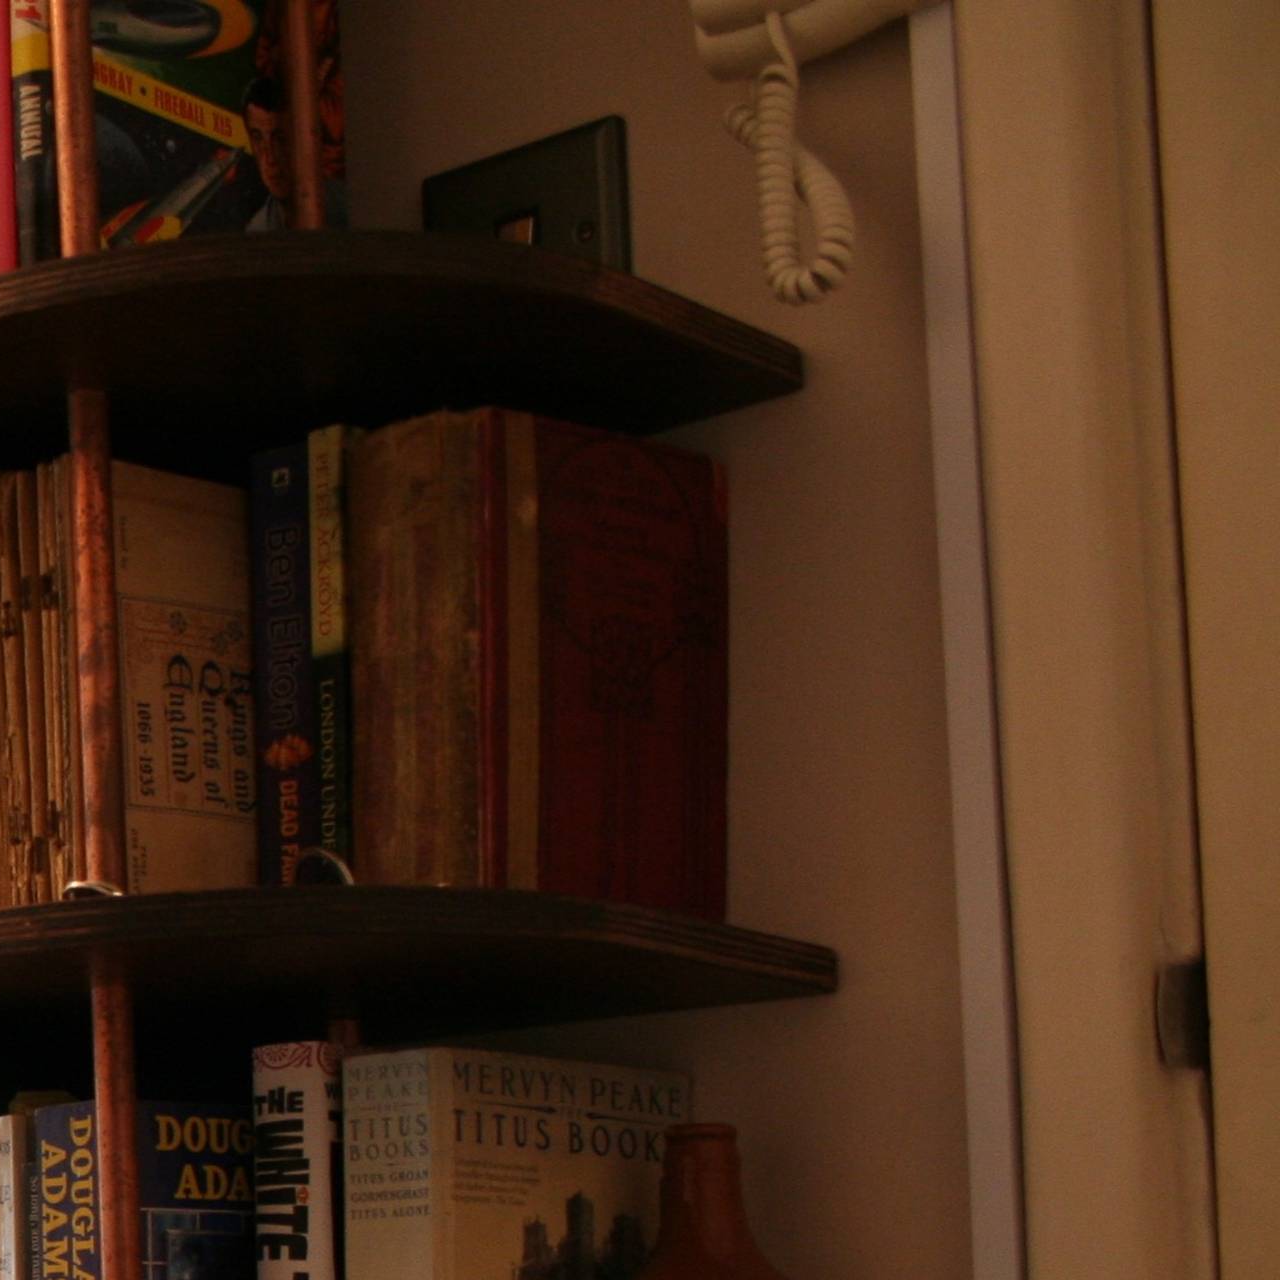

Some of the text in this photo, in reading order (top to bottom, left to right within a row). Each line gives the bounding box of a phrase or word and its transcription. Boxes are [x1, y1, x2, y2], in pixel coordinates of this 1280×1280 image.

[20, 85, 43, 161] ANNUAL
[154, 87, 205, 126] FIREBALL
[254, 1086, 304, 1114] THE
[451, 1060, 681, 1116] MERVYN PEAKE
[349, 1114, 429, 1137] TITUS
[454, 1110, 662, 1161] TITUS BOOK
[349, 1139, 430, 1160] BOOKS
